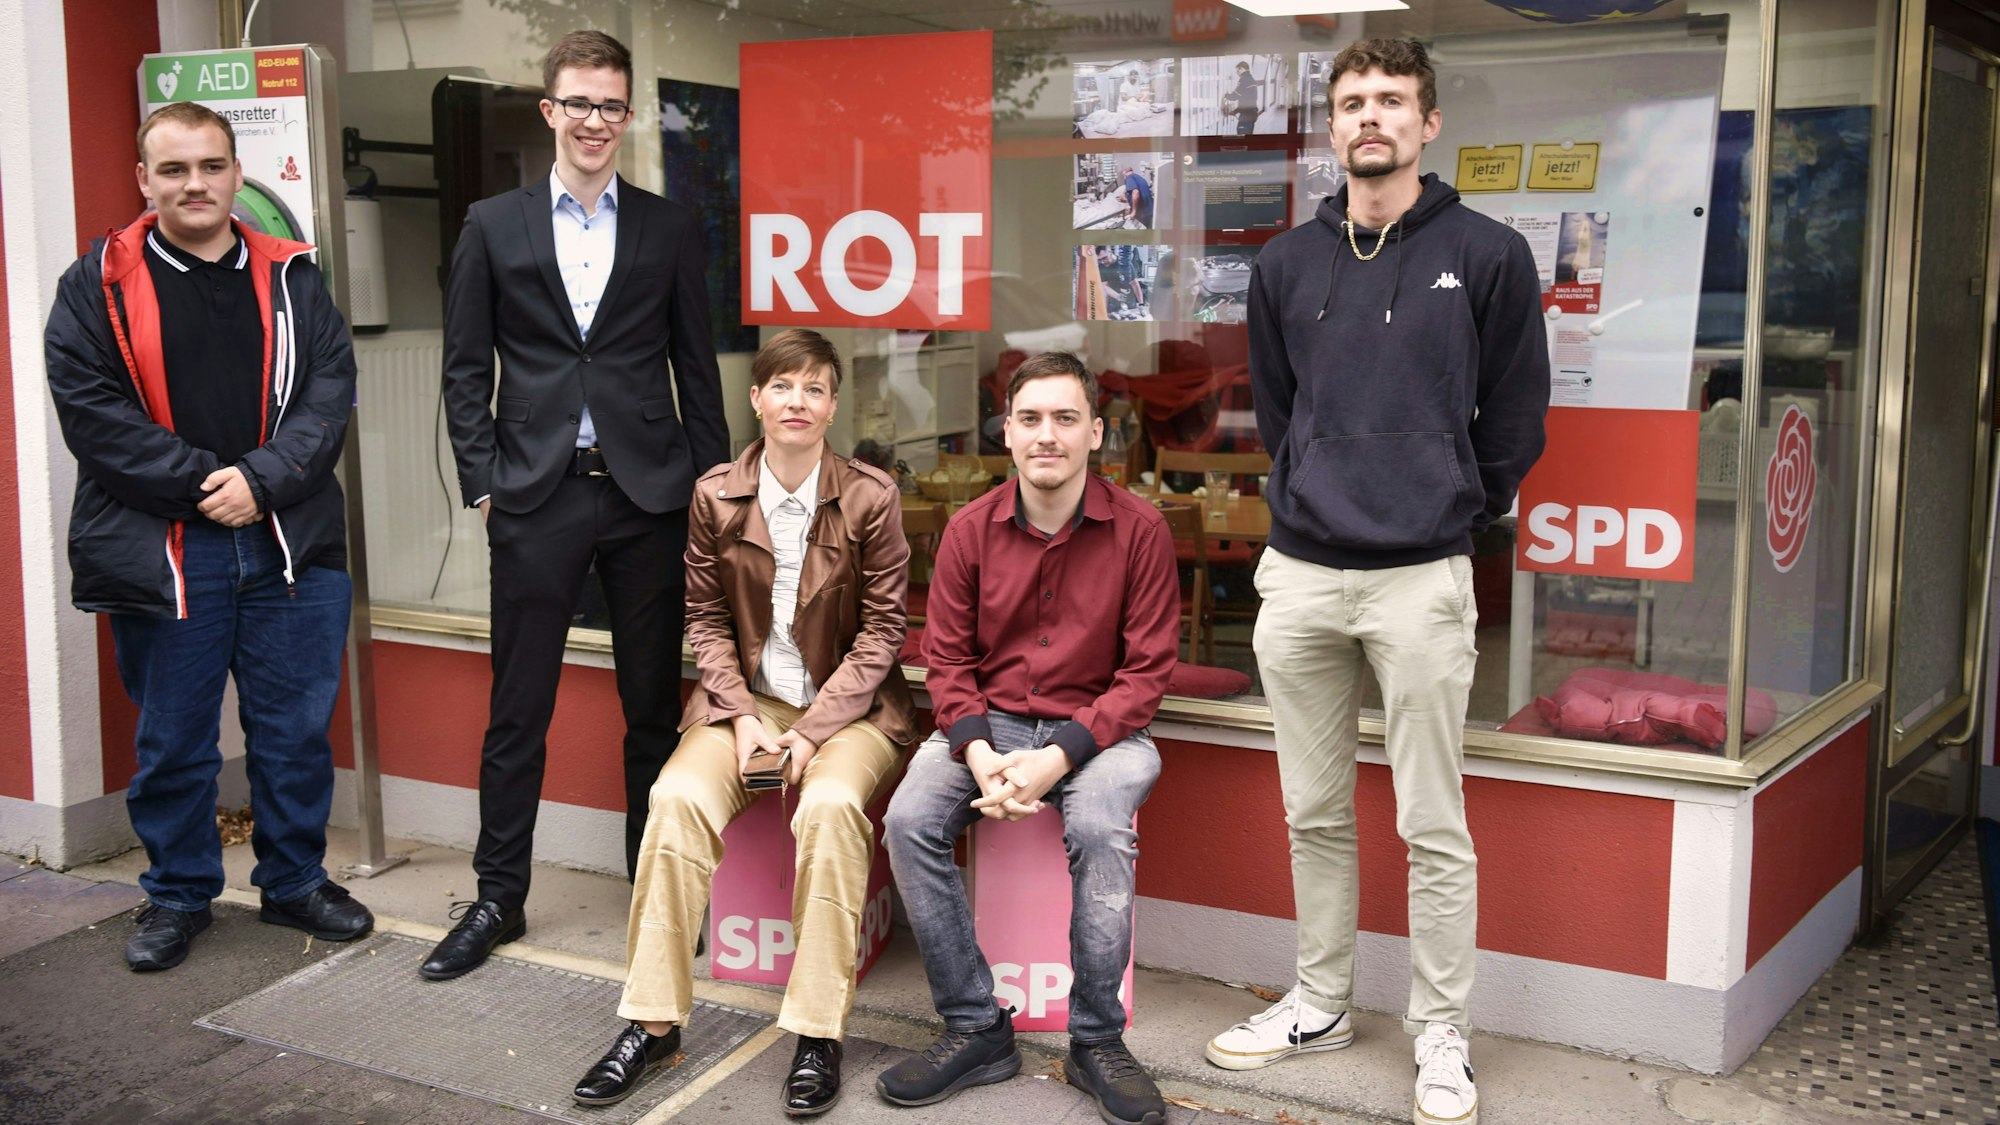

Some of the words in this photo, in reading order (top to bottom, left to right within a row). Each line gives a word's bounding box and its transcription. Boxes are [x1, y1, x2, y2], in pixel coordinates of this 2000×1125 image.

[197, 62, 249, 92] AED
[262, 79, 284, 88] Notruf
[285, 78, 298, 87] 112
[217, 106, 276, 121] ensretter
[234, 127, 261, 136] skirchen
[277, 157, 283, 168] 3
[1472, 162, 1505, 178] jetzt!
[1544, 160, 1580, 176] jetzt!
[750, 210, 983, 317] ROT
[1525, 502, 1682, 569] SPD
[716, 915, 796, 971] SP
[990, 962, 1125, 1018] SP
